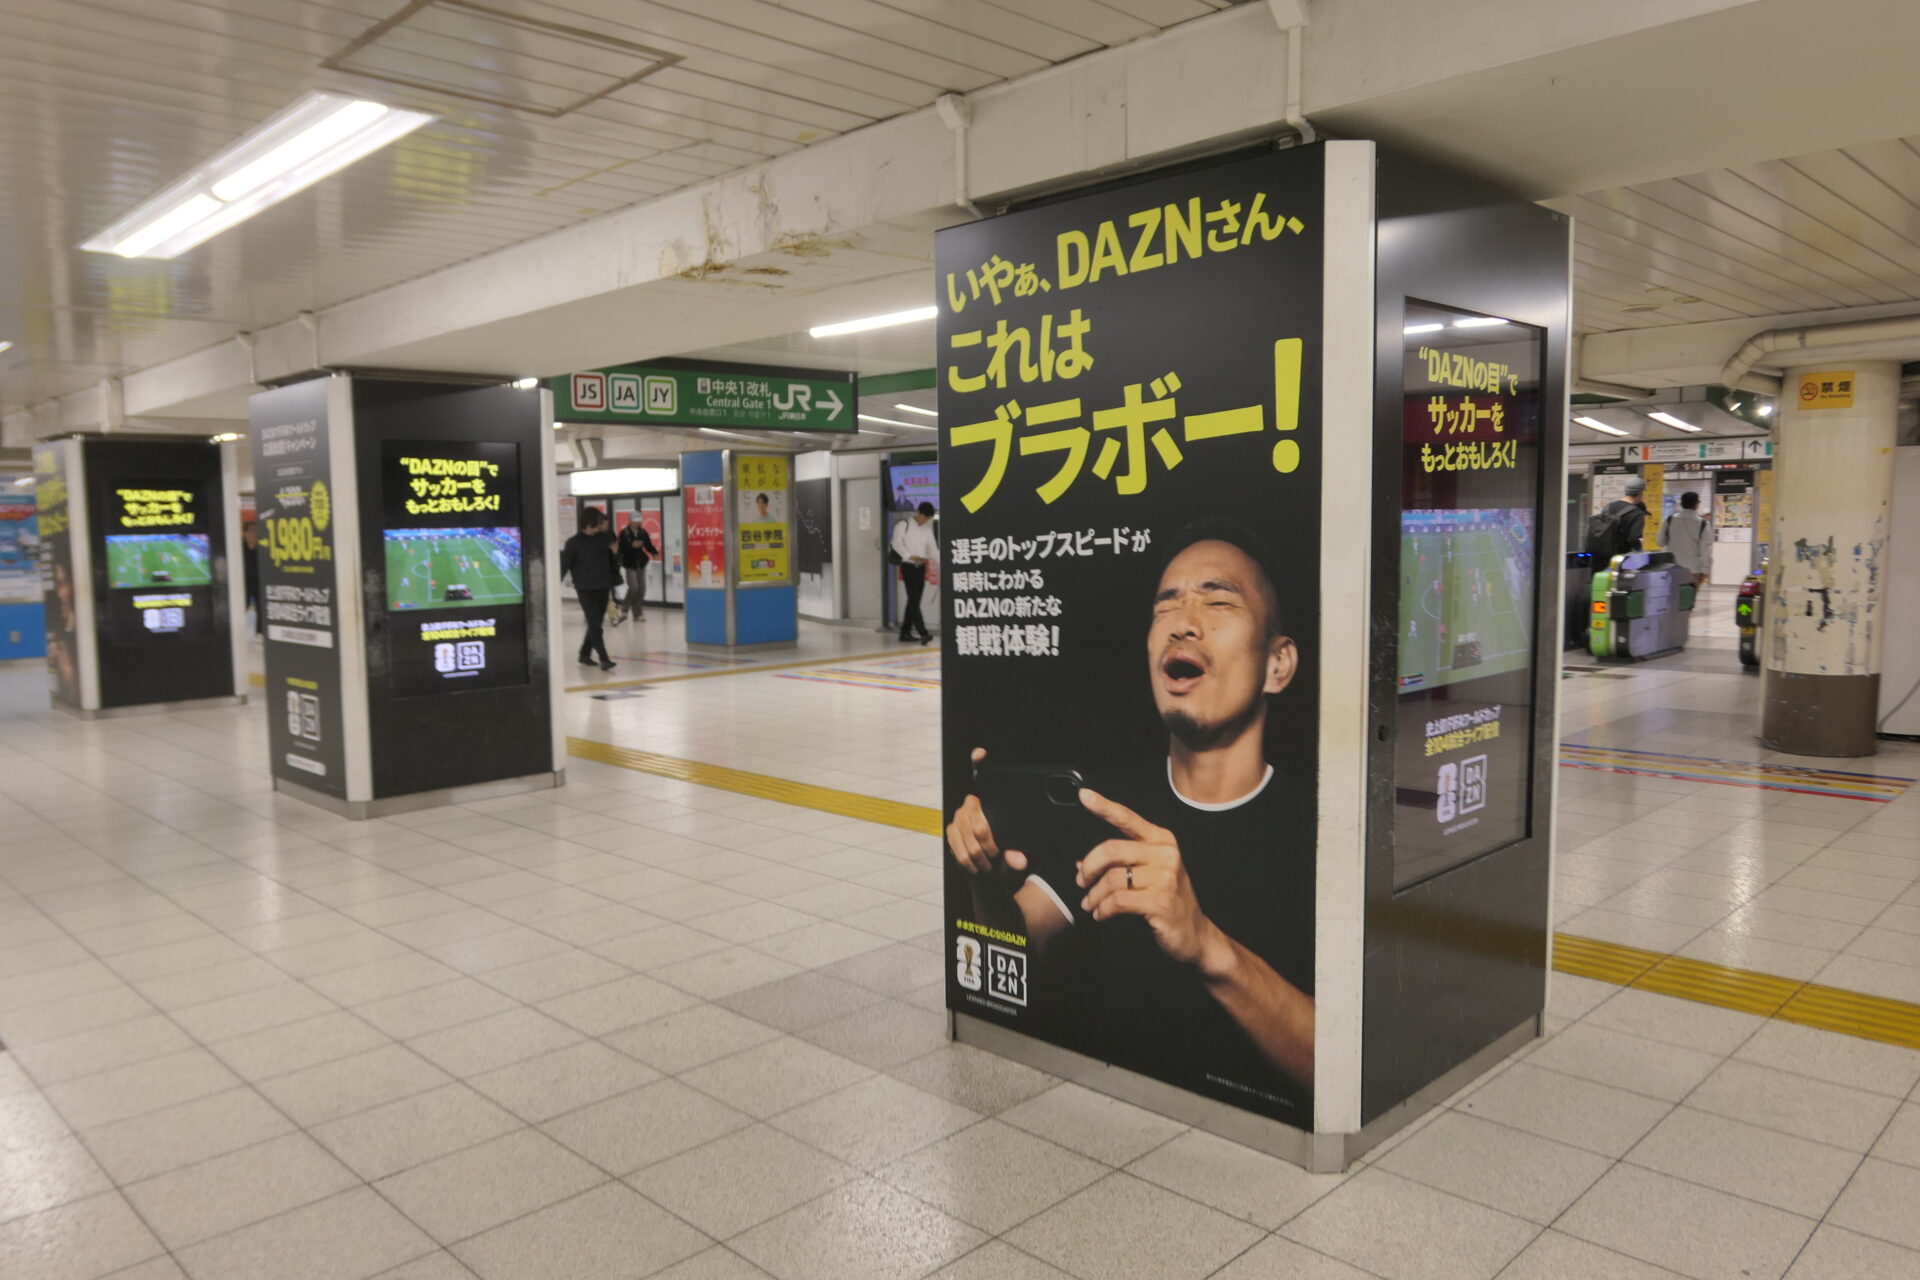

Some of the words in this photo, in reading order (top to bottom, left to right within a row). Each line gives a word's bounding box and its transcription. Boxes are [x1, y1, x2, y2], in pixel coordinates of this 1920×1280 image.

[948, 308, 1094, 393] これは
[580, 383, 597, 399] JS
[615, 388, 636, 402] JA
[651, 387, 670, 402] JY
[711, 378, 772, 398] 中央1改札
[1821, 380, 1852, 393] 禁煙
[706, 395, 740, 408] Central
[742, 398, 764, 409] Gate
[767, 399, 772, 409] 1
[772, 384, 812, 412] JR
[1427, 395, 1505, 435] サッカーを
[950, 337, 1303, 514] ブラボー!
[1421, 439, 1517, 473] もっとおもしろく!
[410, 477, 486, 497] サッカーを
[406, 495, 500, 515] もっとおもしろく!
[741, 529, 784, 542] 四谷学院
[951, 527, 1151, 565] 選手のトップスピードが
[952, 569, 1044, 593] 瞬時にわかる
[954, 595, 1063, 619] DAZNの新たな
[955, 624, 1060, 656] 観戦体験!
[963, 976, 976, 985] FIFA
